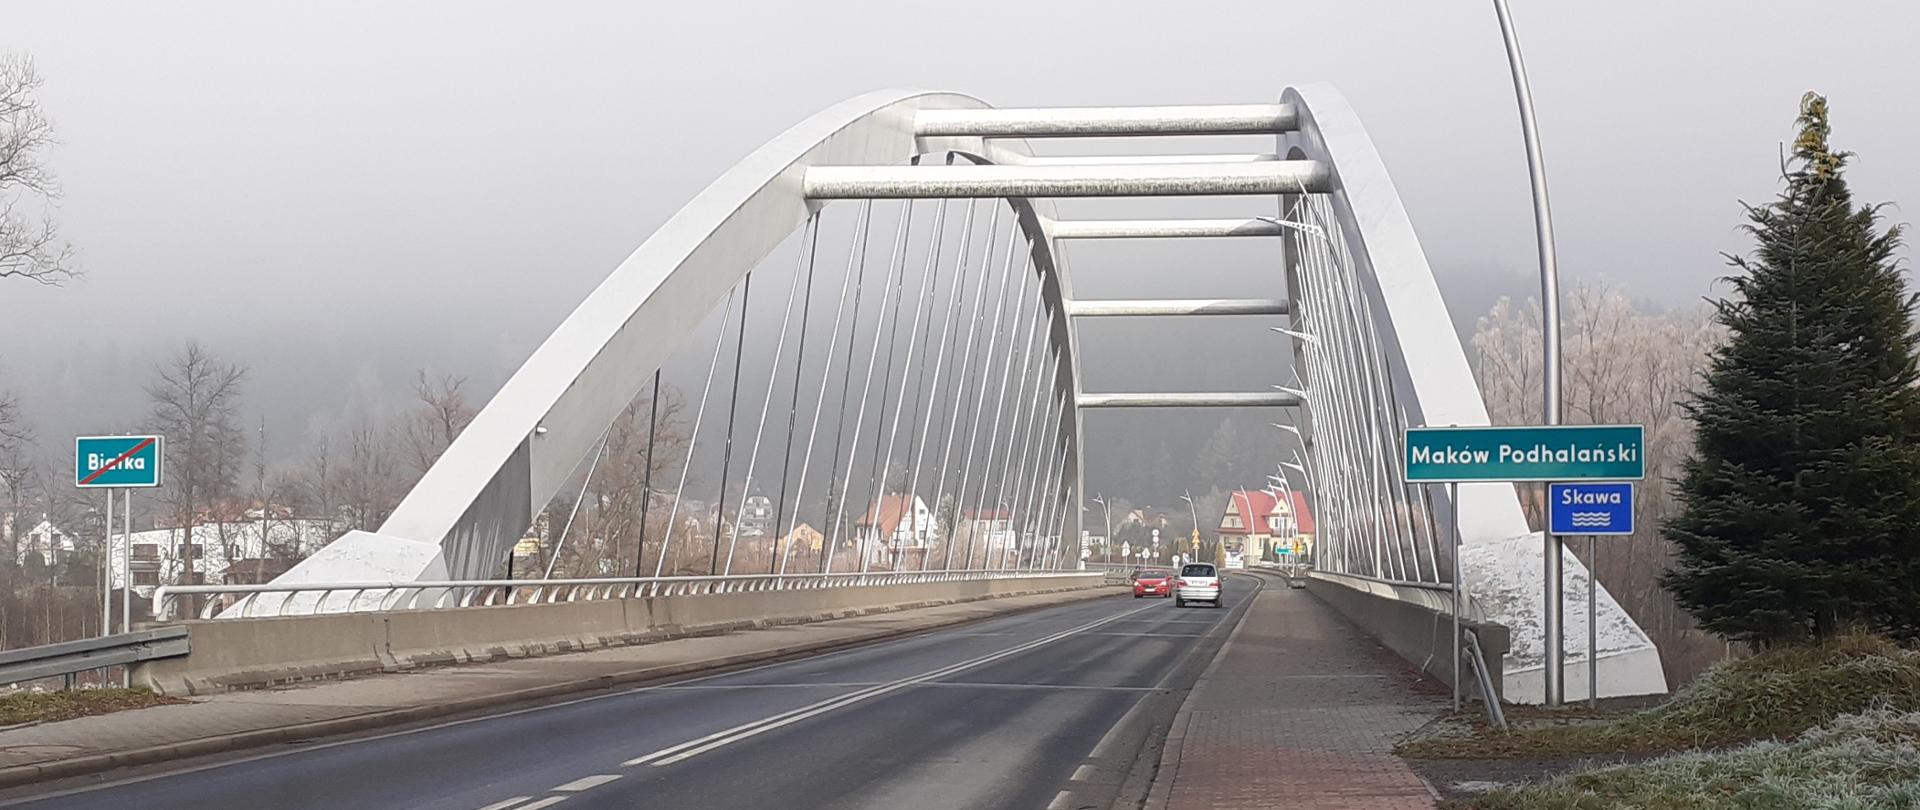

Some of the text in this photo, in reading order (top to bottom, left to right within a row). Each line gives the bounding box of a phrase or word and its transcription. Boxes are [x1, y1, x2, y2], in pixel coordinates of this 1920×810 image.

[1411, 443, 1637, 465] Maków Podhalański
[1561, 488, 1622, 505] Skawa
